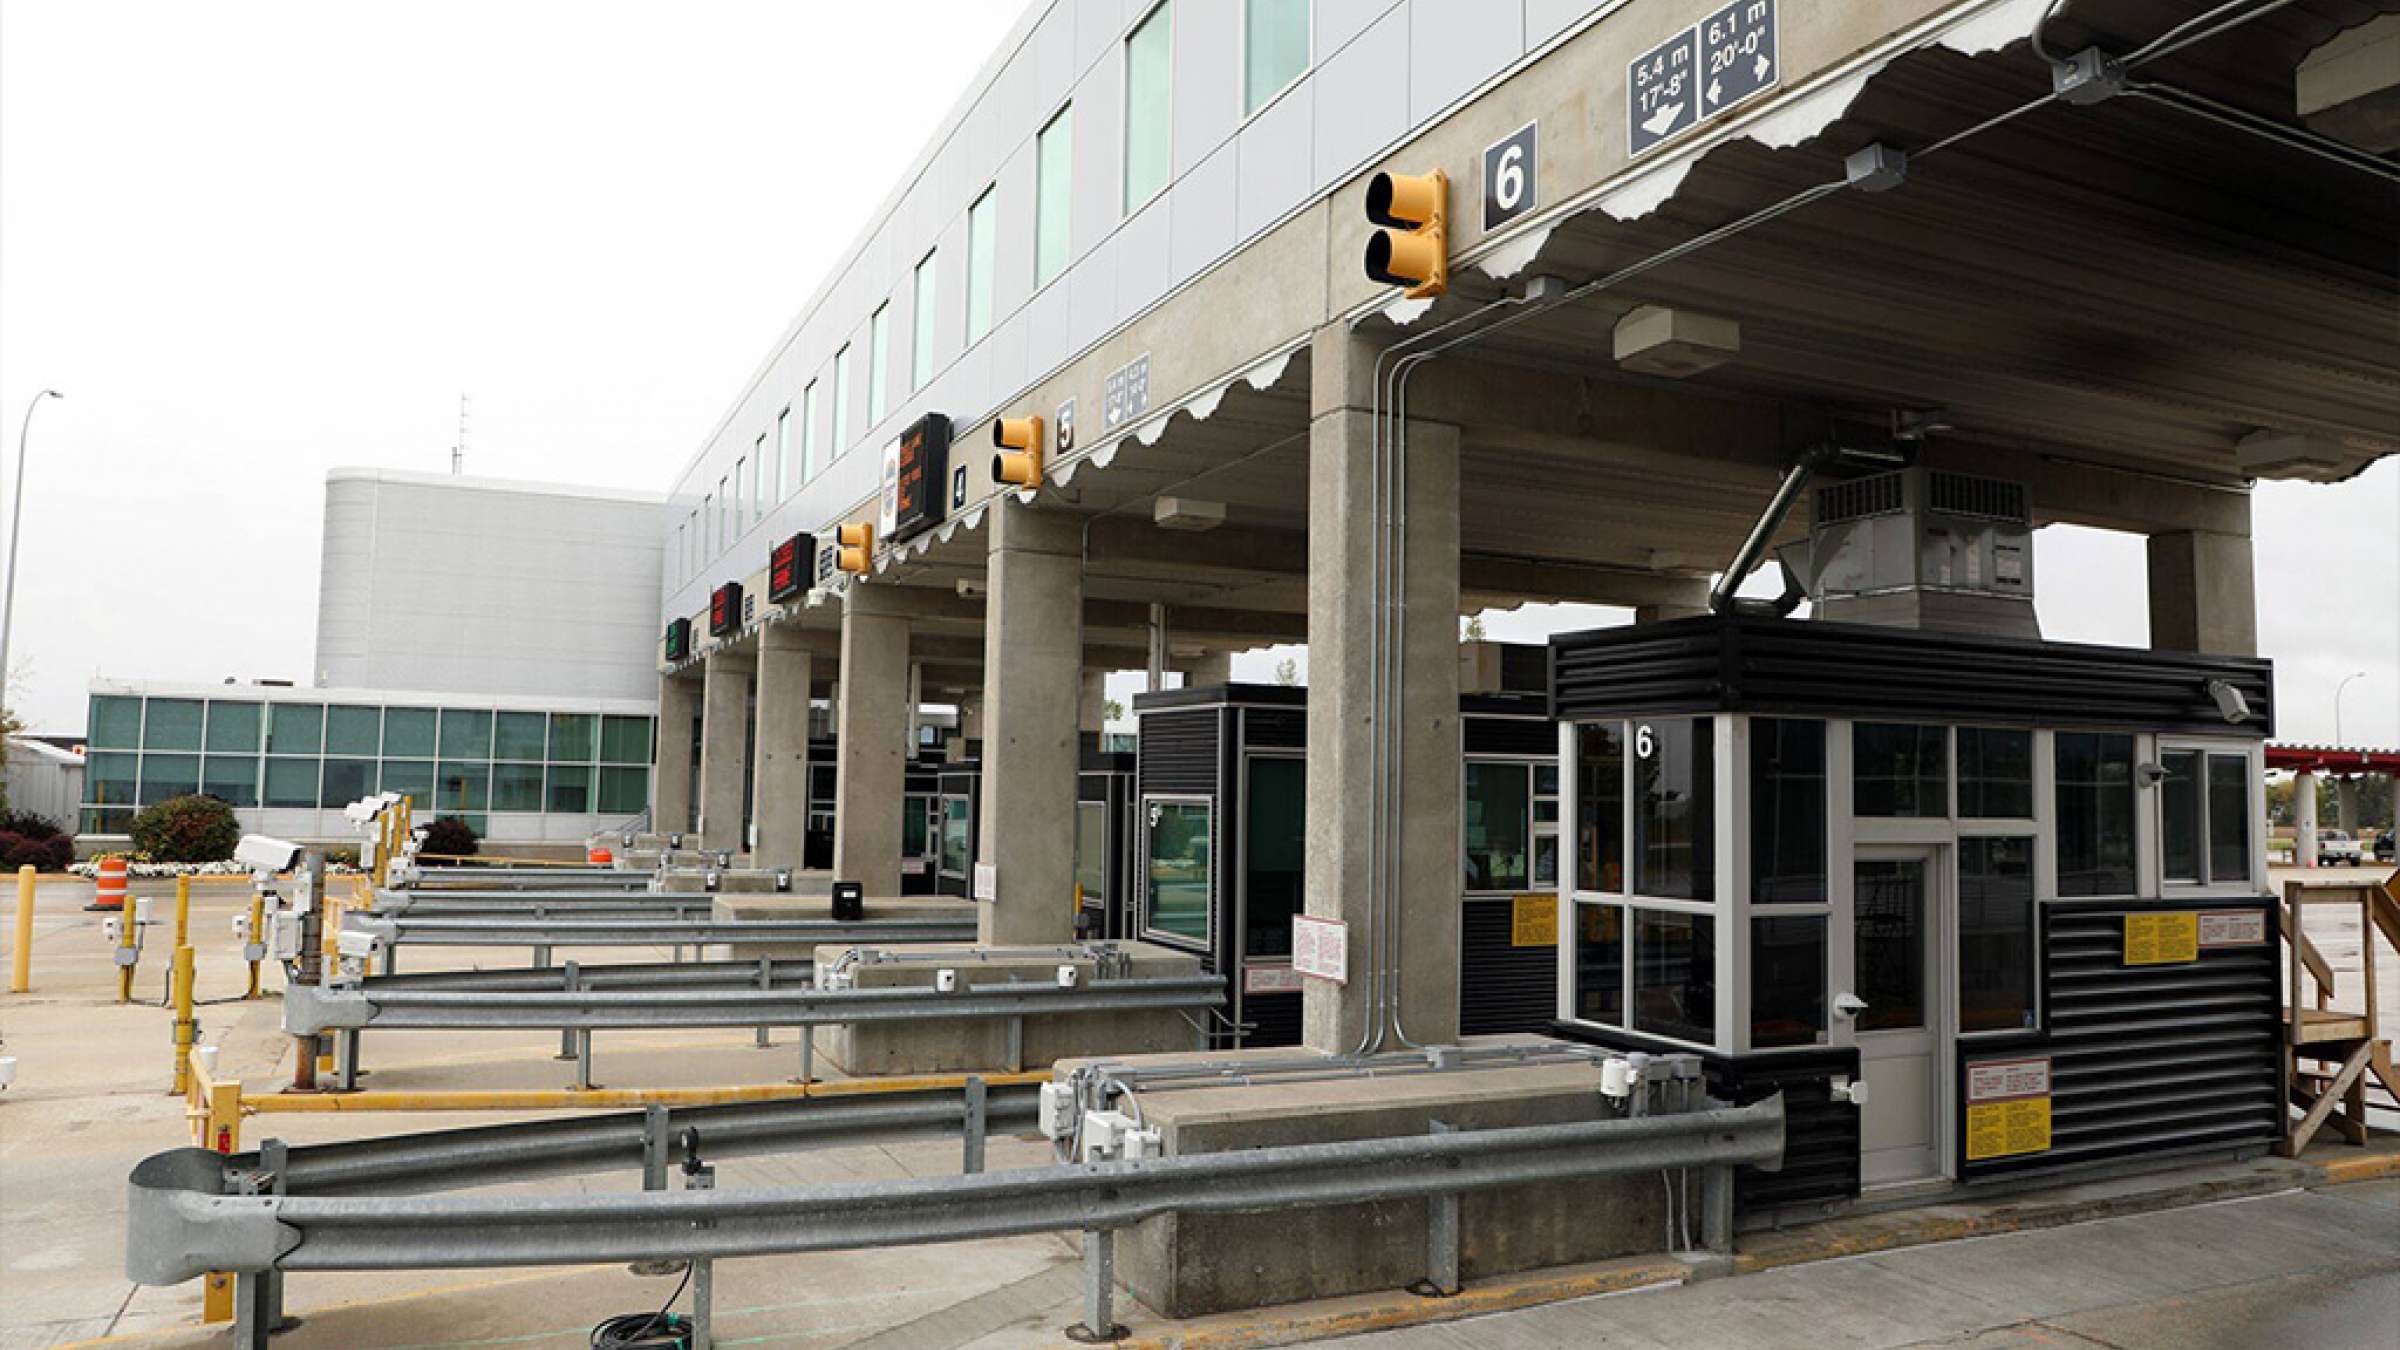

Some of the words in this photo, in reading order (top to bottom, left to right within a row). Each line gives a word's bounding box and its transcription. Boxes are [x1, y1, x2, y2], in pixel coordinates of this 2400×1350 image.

[1709, 12, 1736, 45] 6.1
[1748, 1, 1766, 24] m
[1637, 55, 1664, 87] 5.4
[1671, 44, 1688, 68] m
[1496, 144, 1524, 210] 6
[1061, 409, 1072, 448] 5
[1636, 725, 1653, 759] 6
